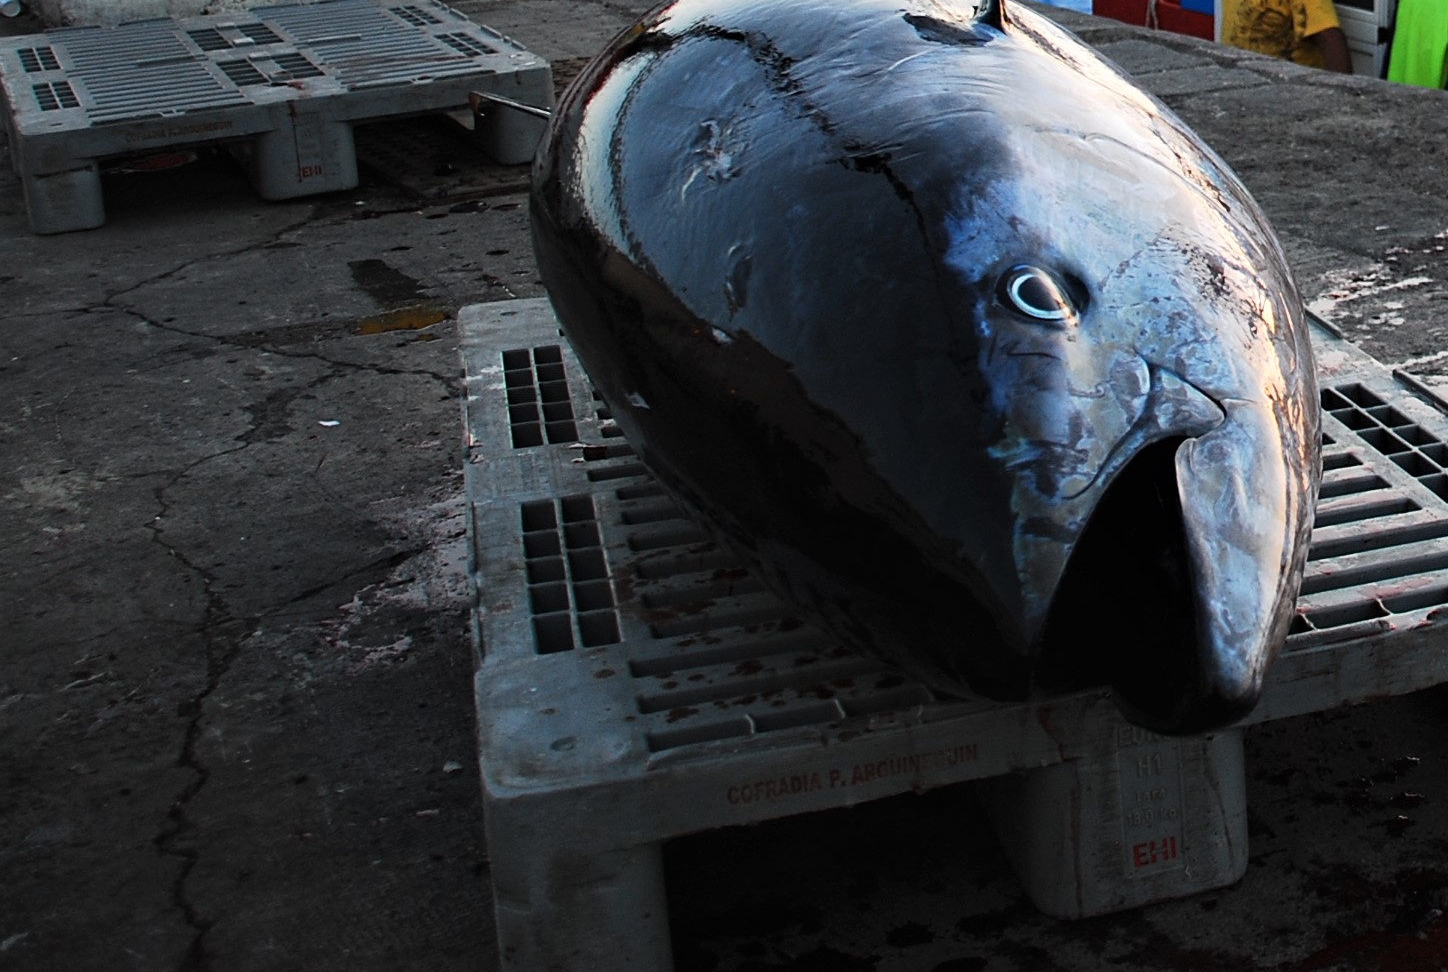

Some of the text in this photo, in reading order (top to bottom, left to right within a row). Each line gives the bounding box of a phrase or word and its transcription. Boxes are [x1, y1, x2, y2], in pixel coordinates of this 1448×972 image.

[727, 772, 821, 804] COFRADIA
[851, 743, 978, 785] ARGUINUIN
[1137, 753, 1162, 777] H1
[1133, 836, 1177, 868] EHI
